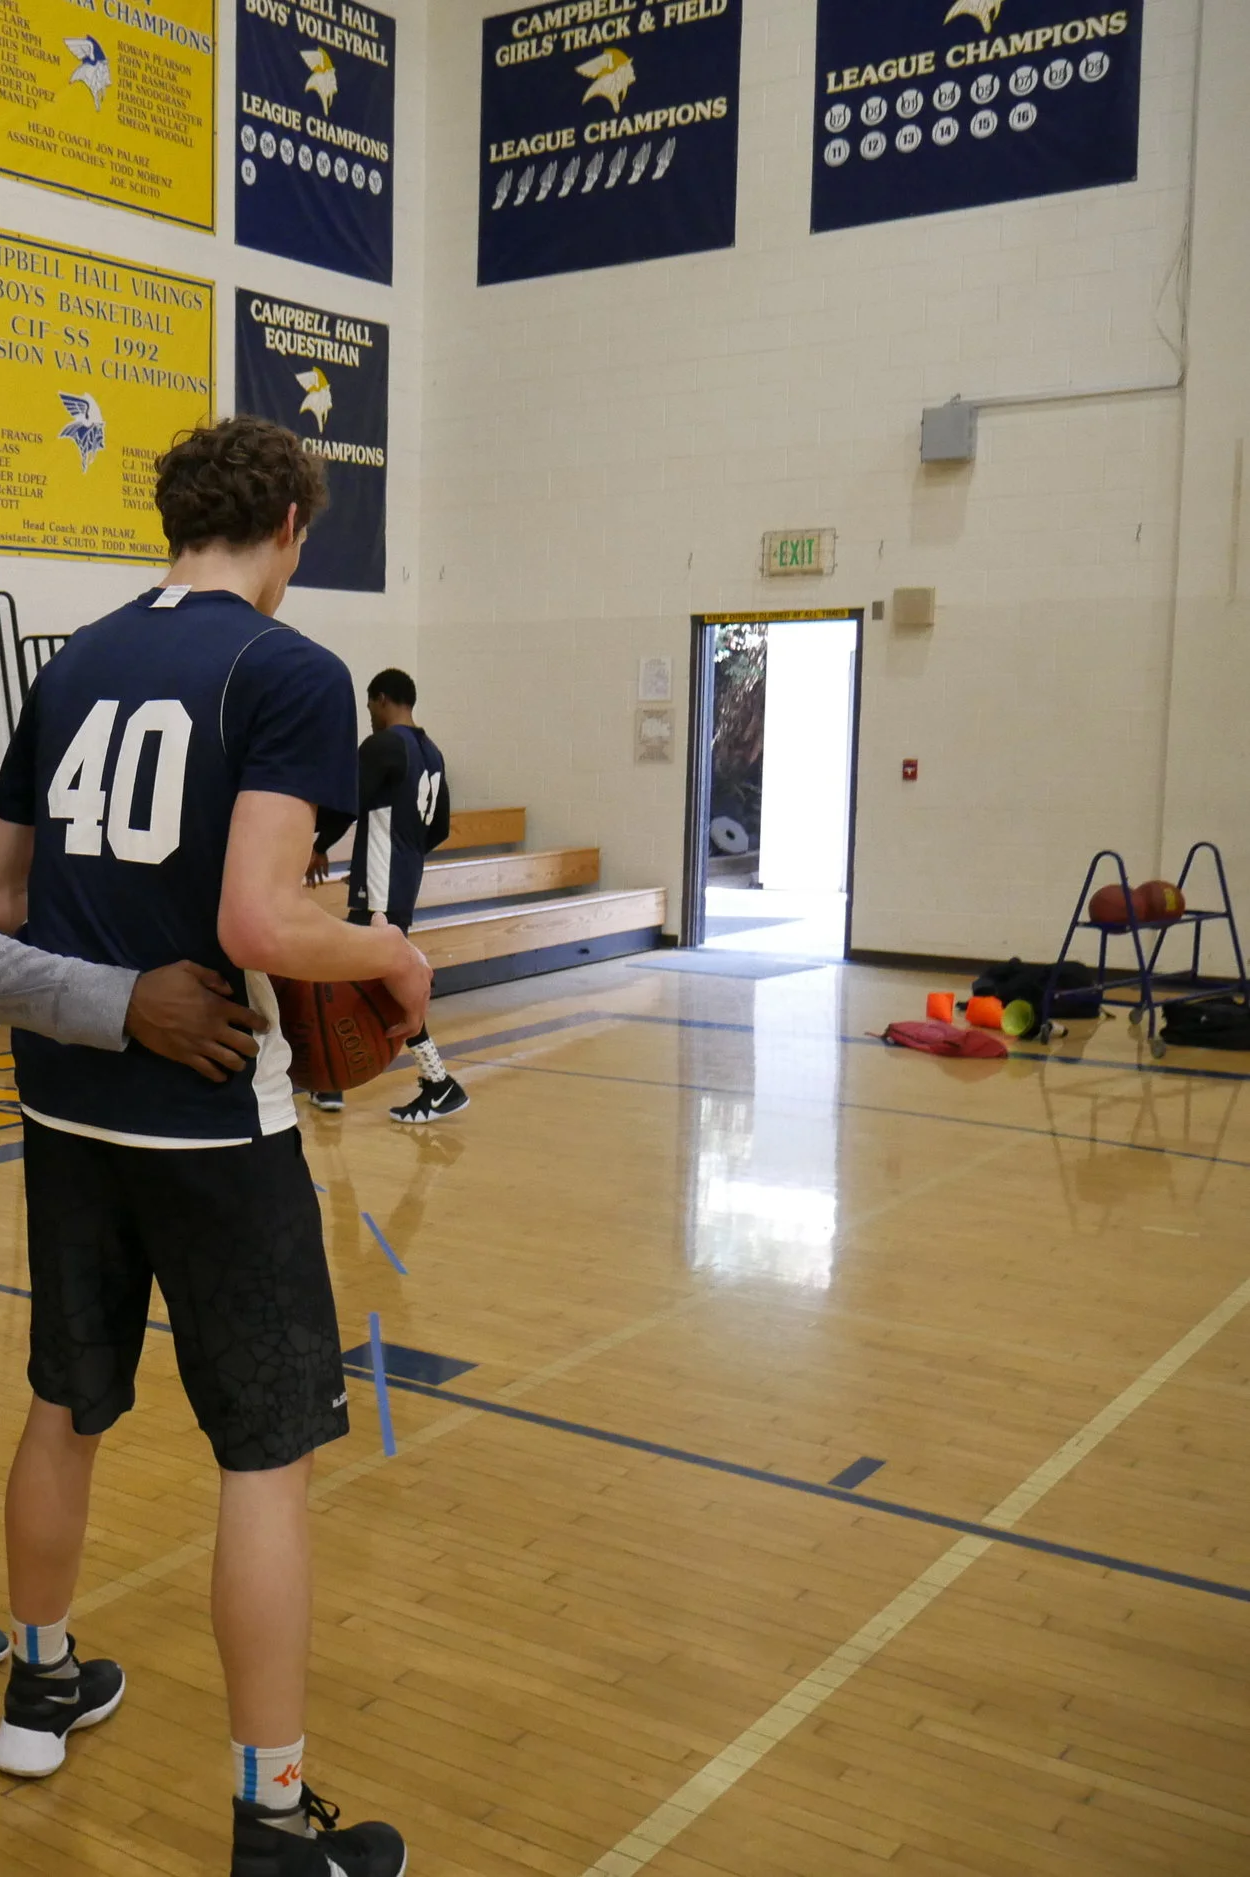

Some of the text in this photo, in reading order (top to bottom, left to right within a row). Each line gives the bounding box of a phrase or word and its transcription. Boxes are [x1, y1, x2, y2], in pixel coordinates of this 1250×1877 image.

[104, 0, 212, 54] CHAMPIONS
[295, 11, 388, 67] VOLLEYBALL
[341, 4, 379, 38] HALL
[560, 19, 631, 52] TRACK
[638, 9, 655, 33] &
[664, 0, 728, 28] FIELD
[826, 10, 1128, 94] LEAGUE CHAMPIONS
[242, 92, 301, 131] LEAGUE
[306, 116, 389, 163] CHAMPIONS
[490, 97, 728, 163] LEAGUE CHAMPIONS
[74, 264, 122, 292] HALL
[132, 277, 203, 311] VIKINGS
[59, 292, 174, 335] BASKETBALL
[250, 299, 373, 347] CAMPBELL HALL
[11, 315, 158, 362] CIF-SS 1992
[264, 327, 360, 368] EQUESTRIAN
[54, 350, 92, 374] VAA
[102, 360, 208, 395] CHAMPIONS
[1, 429, 43, 443] FRANCIS
[302, 437, 384, 467] CHAMPIONS
[18, 474, 47, 485] LOPEZ
[122, 499, 154, 510] TAYLOR
[23, 519, 45, 531] Head
[81, 525, 99, 536] JON
[41, 535, 59, 545] JOE
[102, 540, 125, 552] TODD
[778, 538, 815, 567] EXIT
[47, 700, 193, 865] 40
